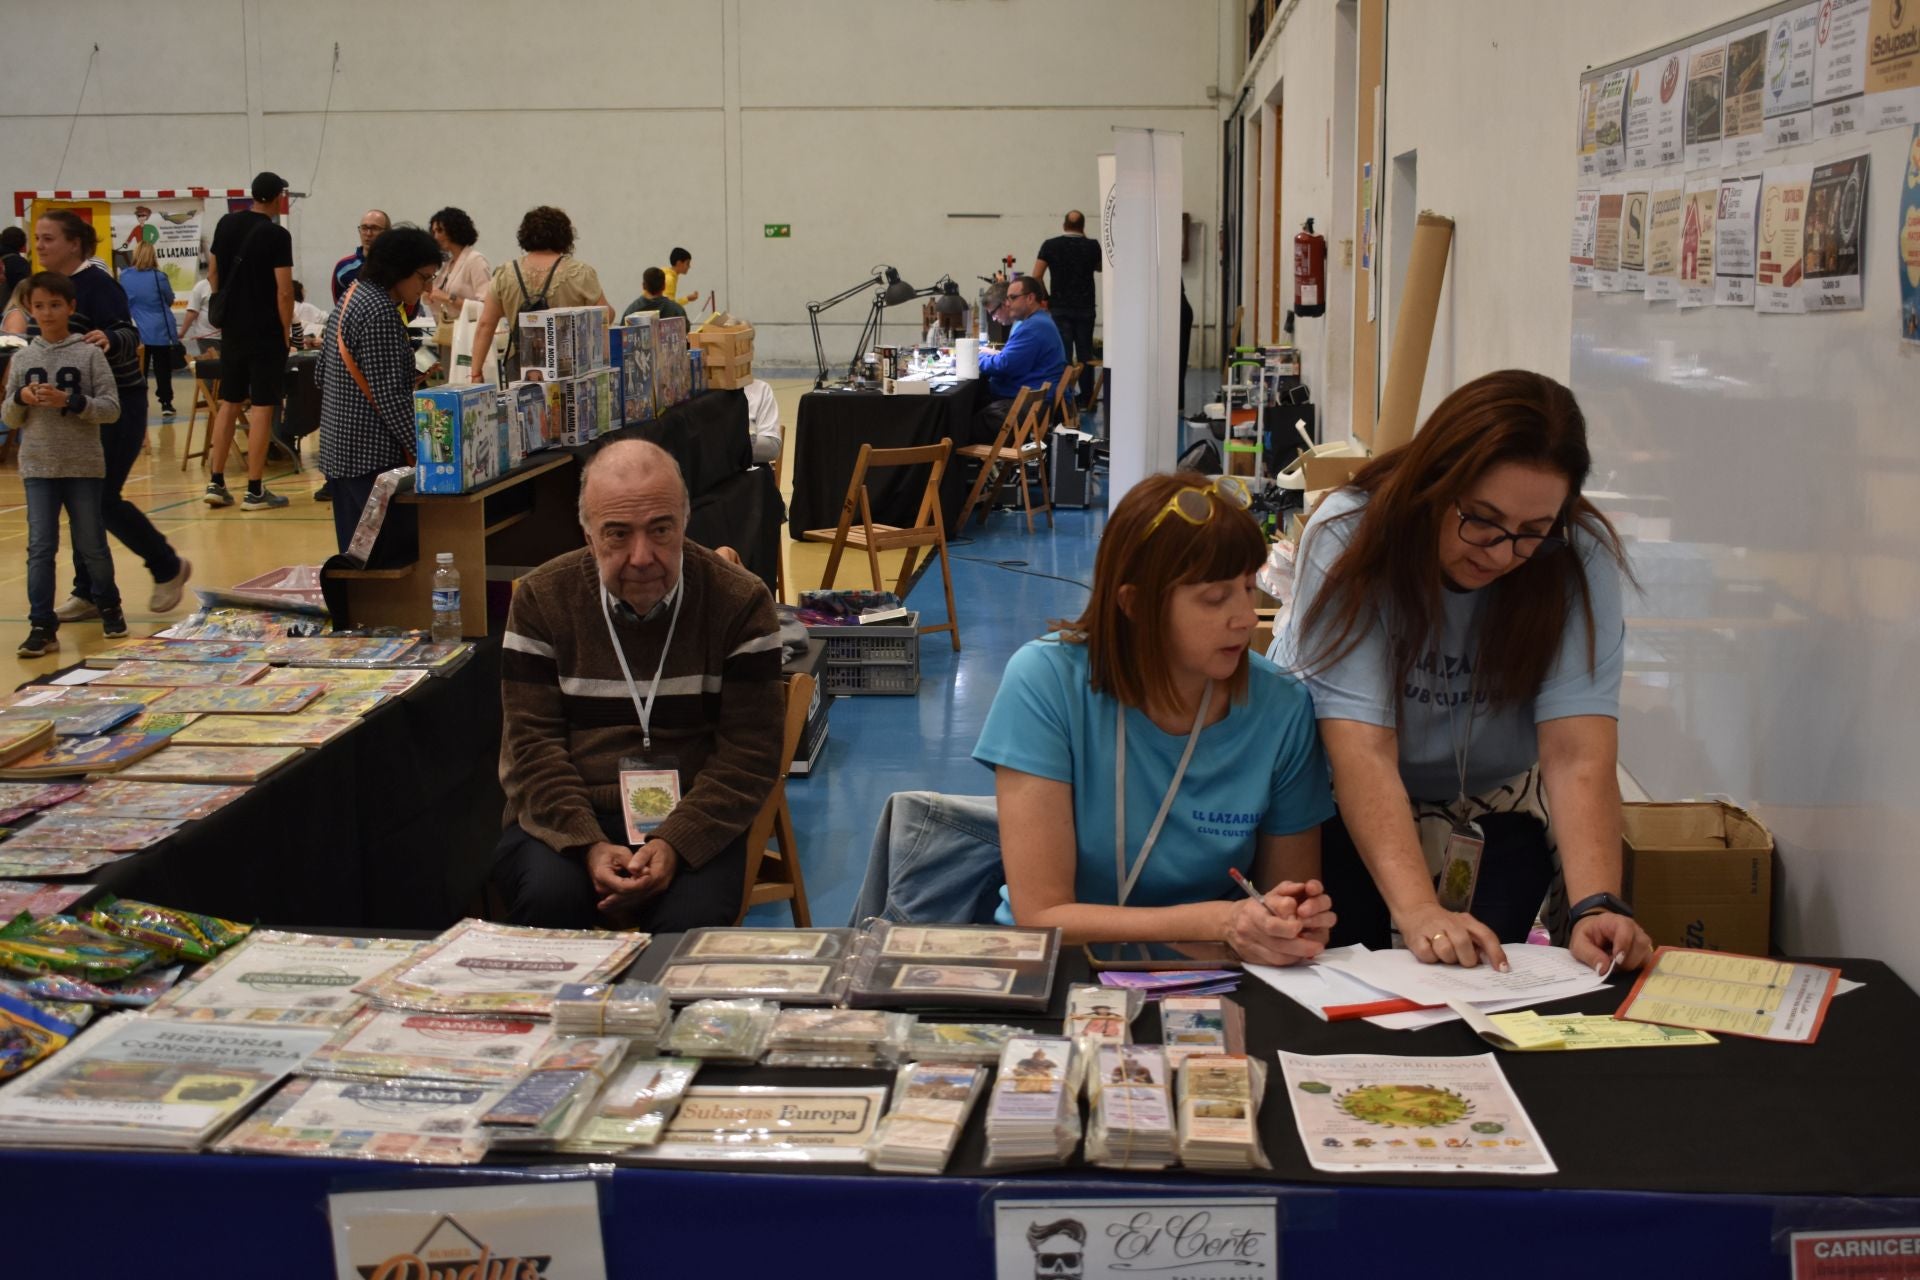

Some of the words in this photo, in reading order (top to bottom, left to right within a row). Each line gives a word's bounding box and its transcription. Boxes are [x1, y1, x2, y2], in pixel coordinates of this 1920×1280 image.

[1874, 25, 1917, 58] Solupack
[156, 248, 165, 259] EL
[167, 246, 199, 258] LAZARILL
[546, 317, 554, 346] SHADOW
[547, 347, 556, 368] MOON
[566, 382, 575, 405] WHITE
[567, 406, 577, 433] MAMBA
[1192, 810, 1205, 821] EL
[1197, 826, 1220, 836] CLUB
[466, 960, 508, 970] FLORA
[522, 962, 565, 971] FAUNA
[121, 1039, 300, 1060] CONSERVERA
[156, 1031, 283, 1048] HISTORIA
[682, 1103, 773, 1120] Subastas
[778, 1104, 857, 1124] Europa
[785, 1135, 835, 1144] Barcelona
[1105, 1211, 1160, 1260] El
[1165, 1211, 1267, 1258] Corte
